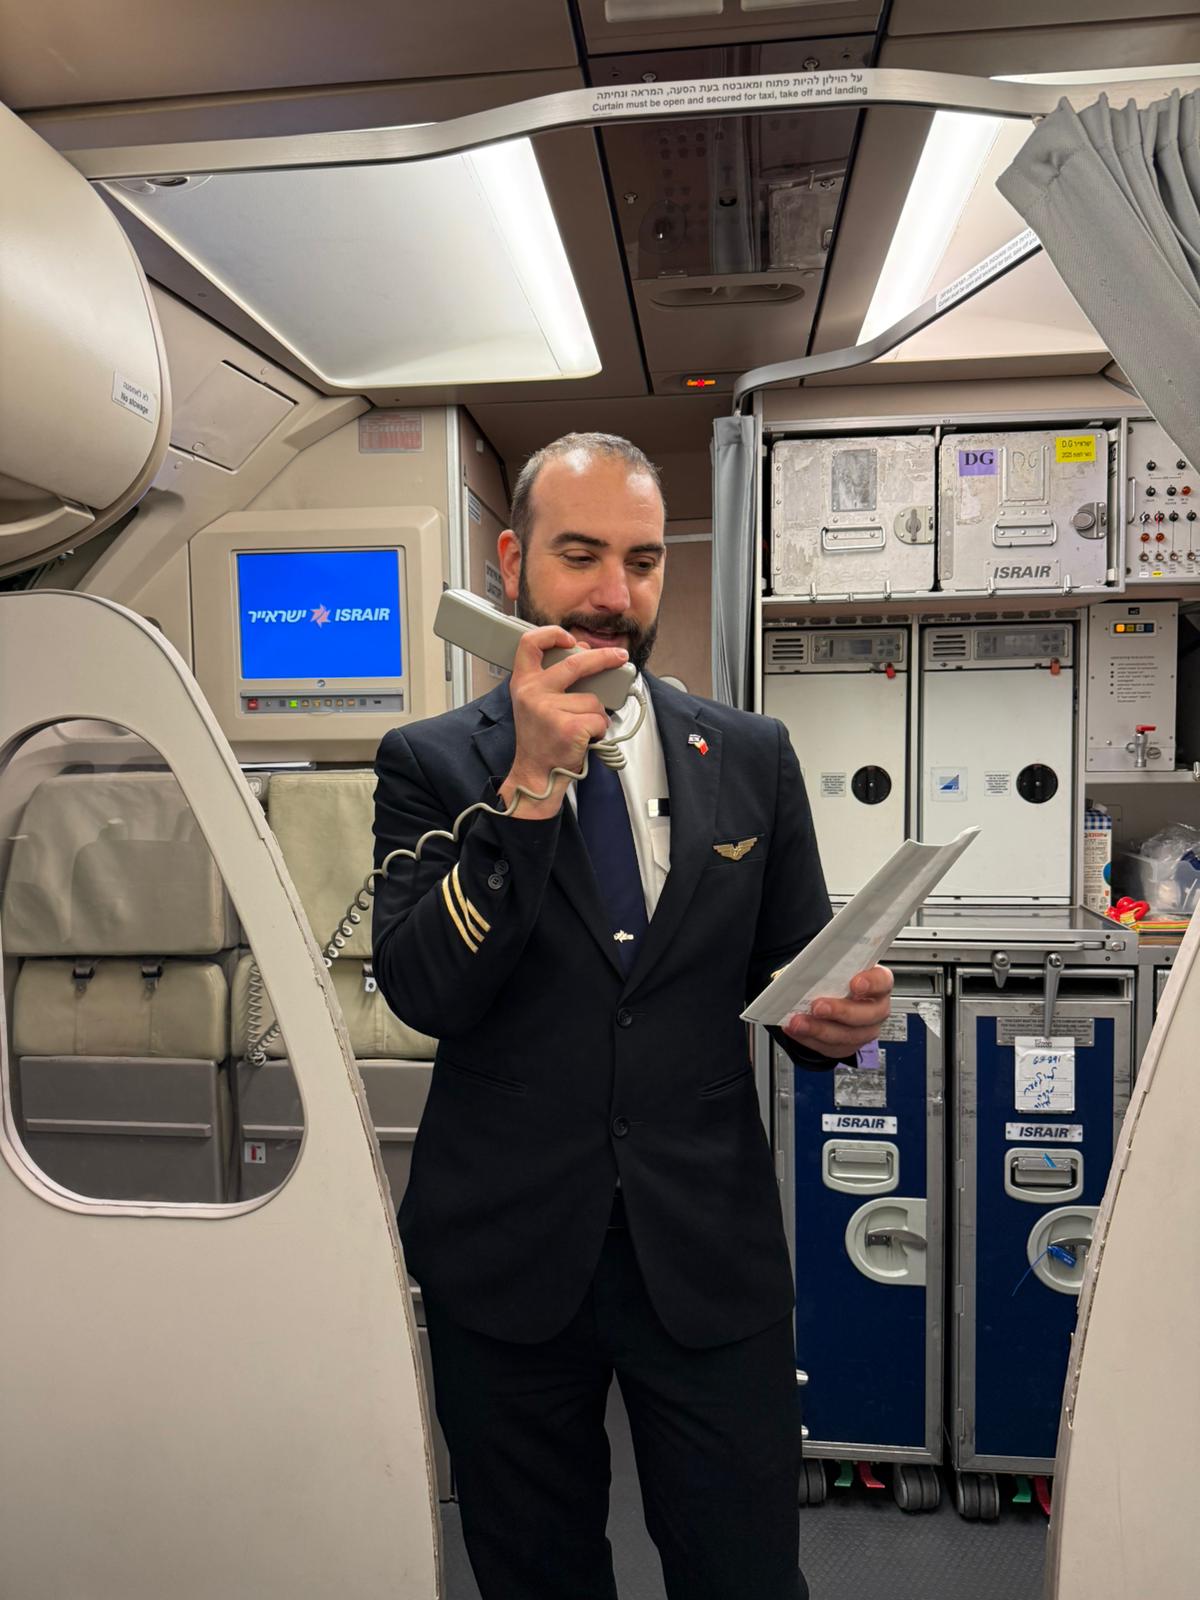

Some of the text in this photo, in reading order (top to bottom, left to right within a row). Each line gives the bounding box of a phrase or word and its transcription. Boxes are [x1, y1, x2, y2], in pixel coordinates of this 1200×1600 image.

[597, 73, 863, 100] על הוילון להיות פתוח ומאובטח בעת הסעה, המראה ונחיתה
[592, 86, 868, 112] Curtain must be open and secured for taxi, take off and landing
[964, 451, 994, 466] DG
[993, 565, 1051, 580] ISRAIR
[248, 609, 307, 624] ישראייר
[335, 607, 391, 622] ISRAIR
[837, 1117, 886, 1129] ISRAIR
[1018, 1127, 1069, 1139] ISRAIR
